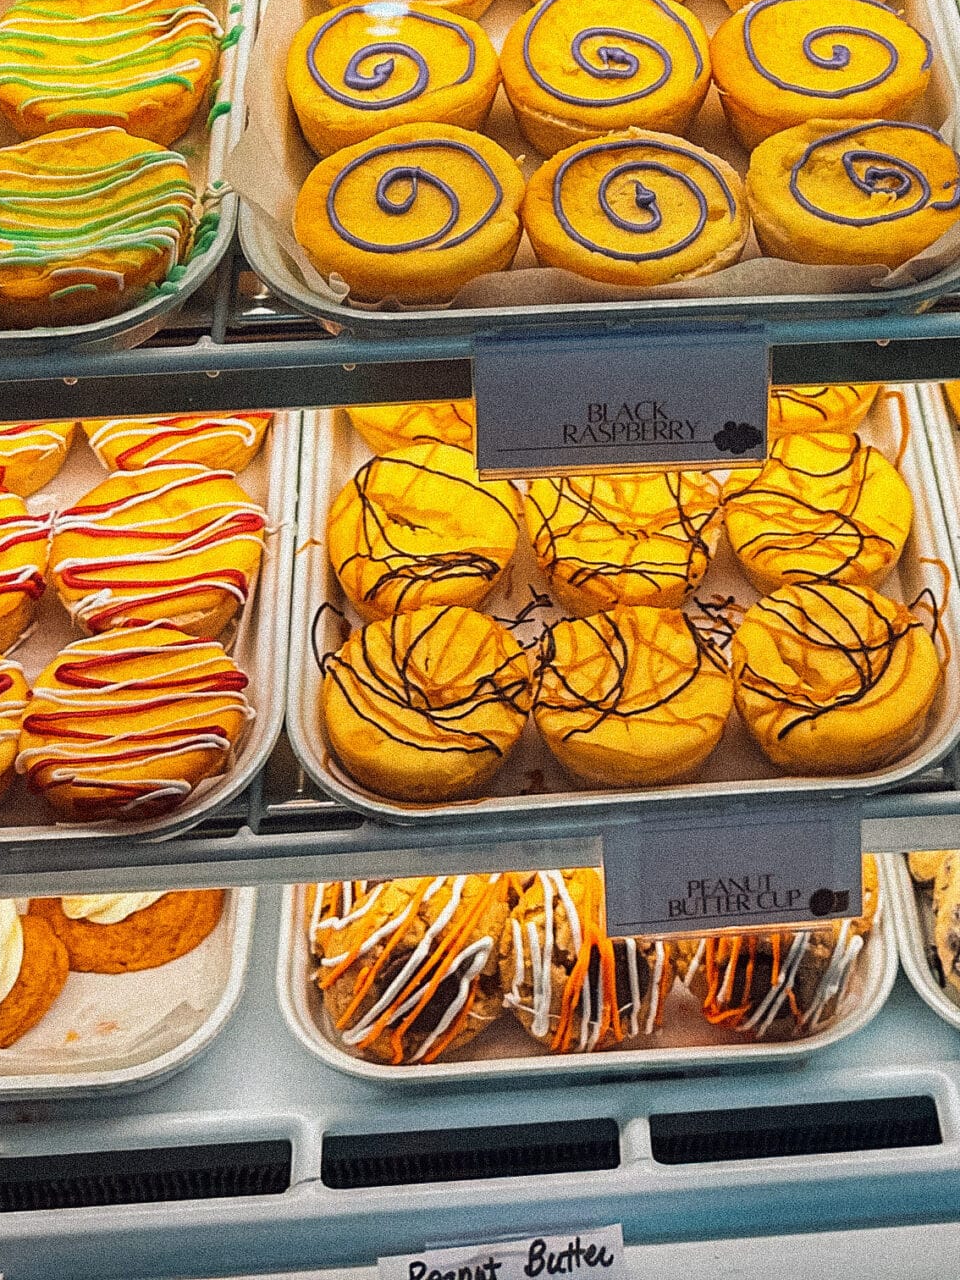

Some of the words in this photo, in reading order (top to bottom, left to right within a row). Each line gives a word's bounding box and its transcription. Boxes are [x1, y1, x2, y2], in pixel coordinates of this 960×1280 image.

[587, 400, 668, 423] BLACK
[563, 419, 698, 444] RASPBERRY
[688, 874, 775, 898] PEANUT
[667, 894, 751, 918] BUTTER
[757, 889, 801, 910] CUP
[524, 1236, 615, 1278] Butter
